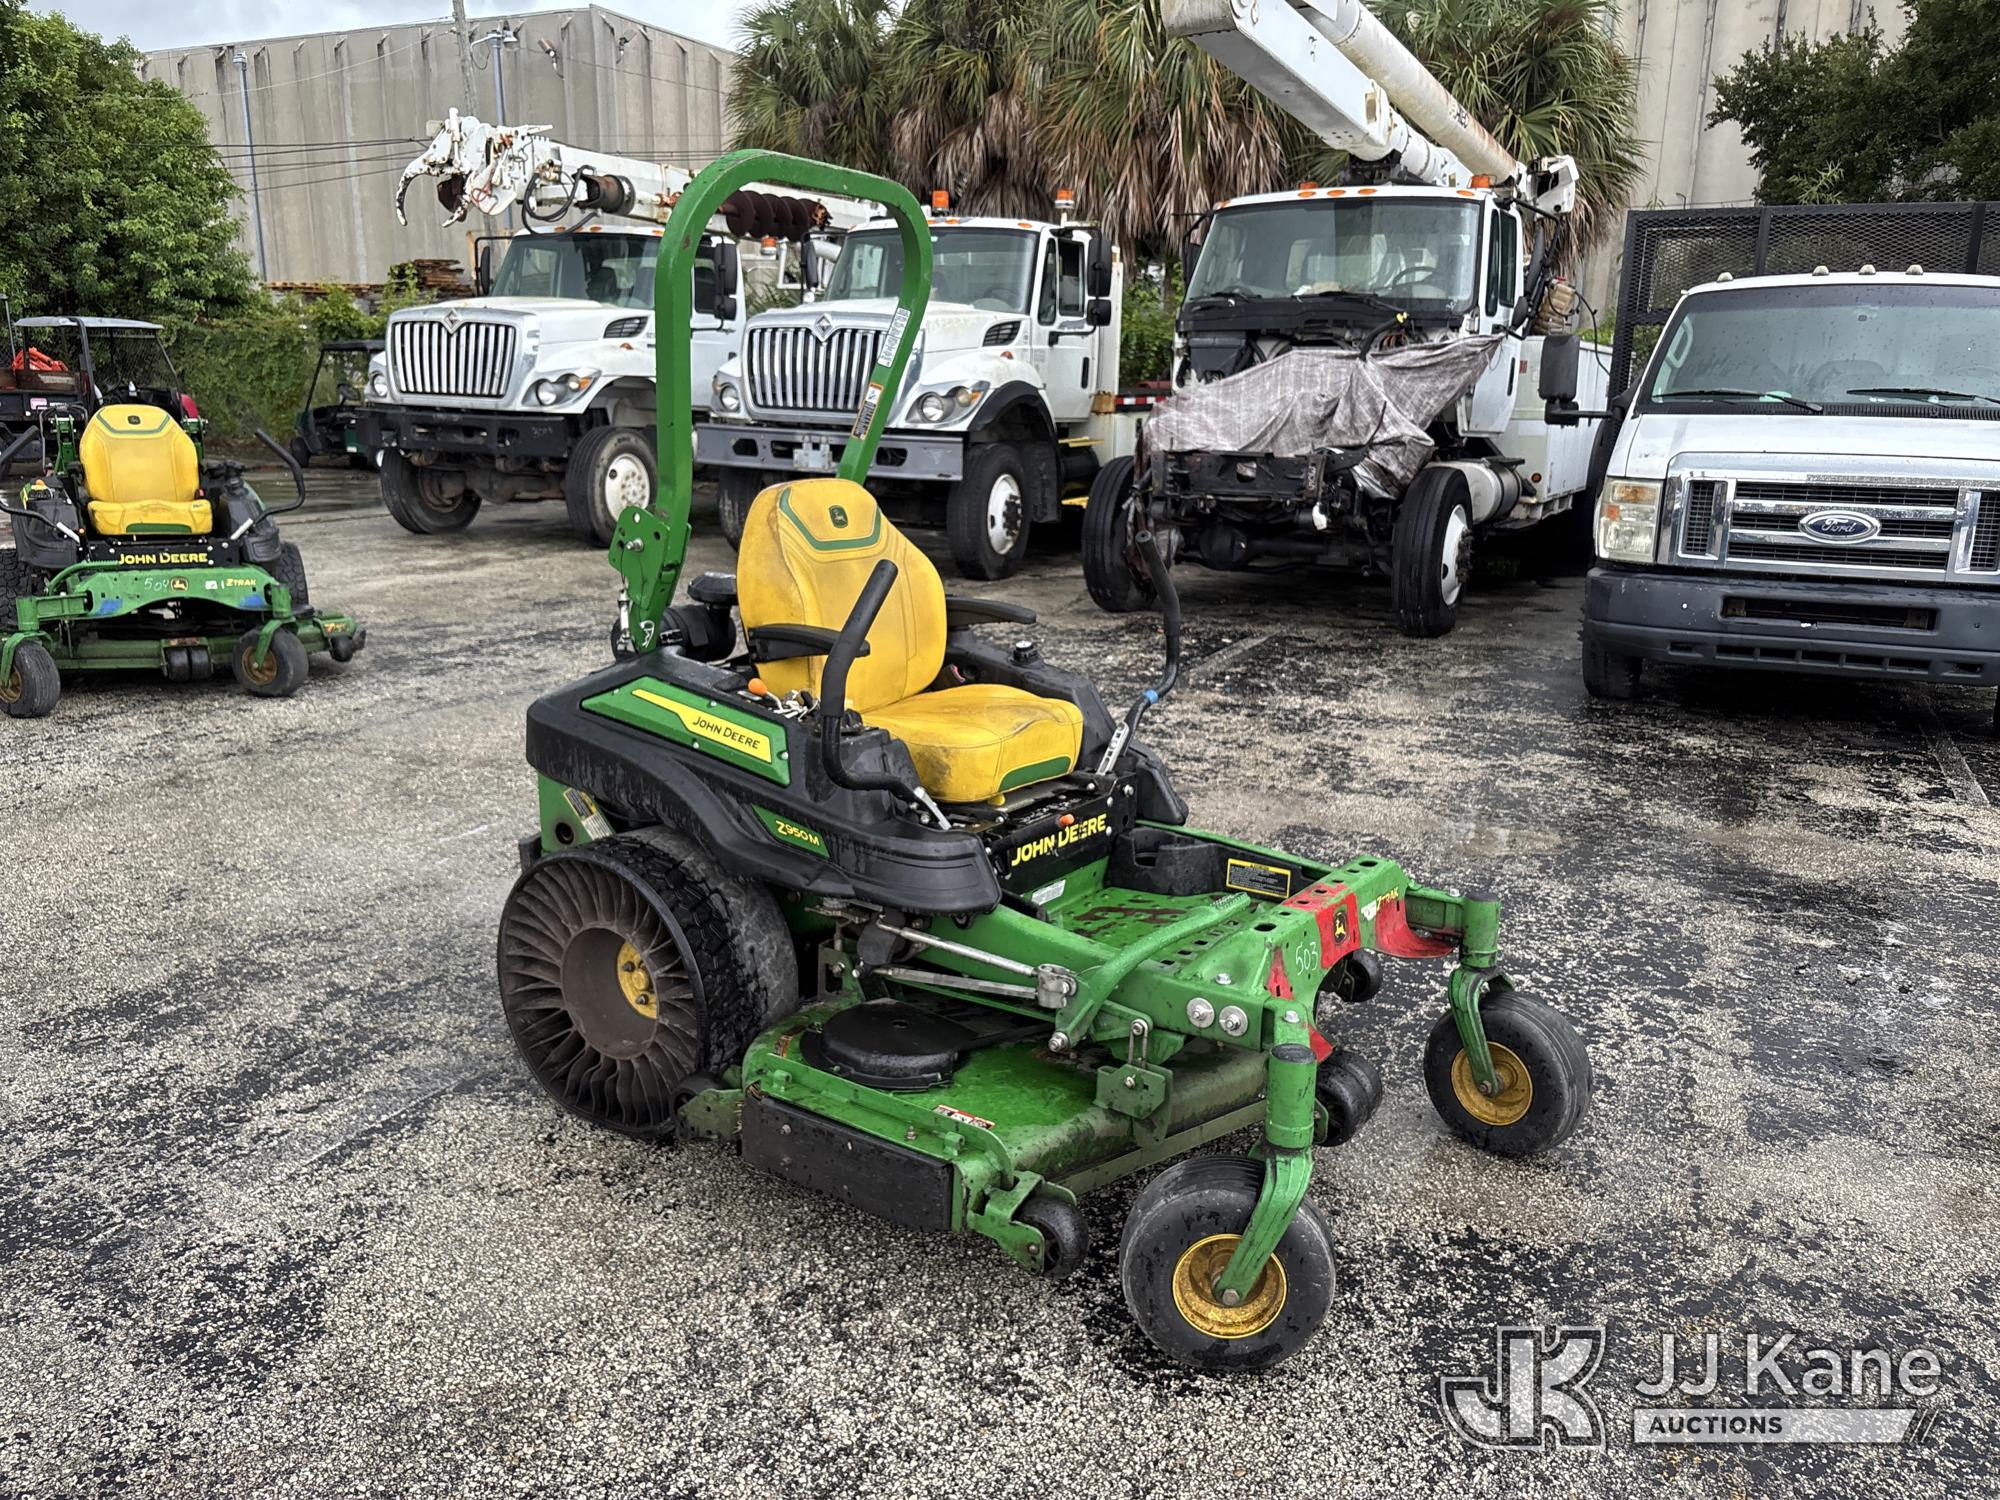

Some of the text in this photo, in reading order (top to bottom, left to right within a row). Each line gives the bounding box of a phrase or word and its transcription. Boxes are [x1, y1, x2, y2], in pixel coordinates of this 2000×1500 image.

[1821, 518, 1857, 533] Ford
[118, 552, 208, 565] JOHN DEERE
[692, 716, 761, 750] JOHN DEERE
[775, 820, 820, 846] Z950M
[1010, 813, 1107, 867] JOHN DEERE
[1295, 941, 1319, 976] 503
